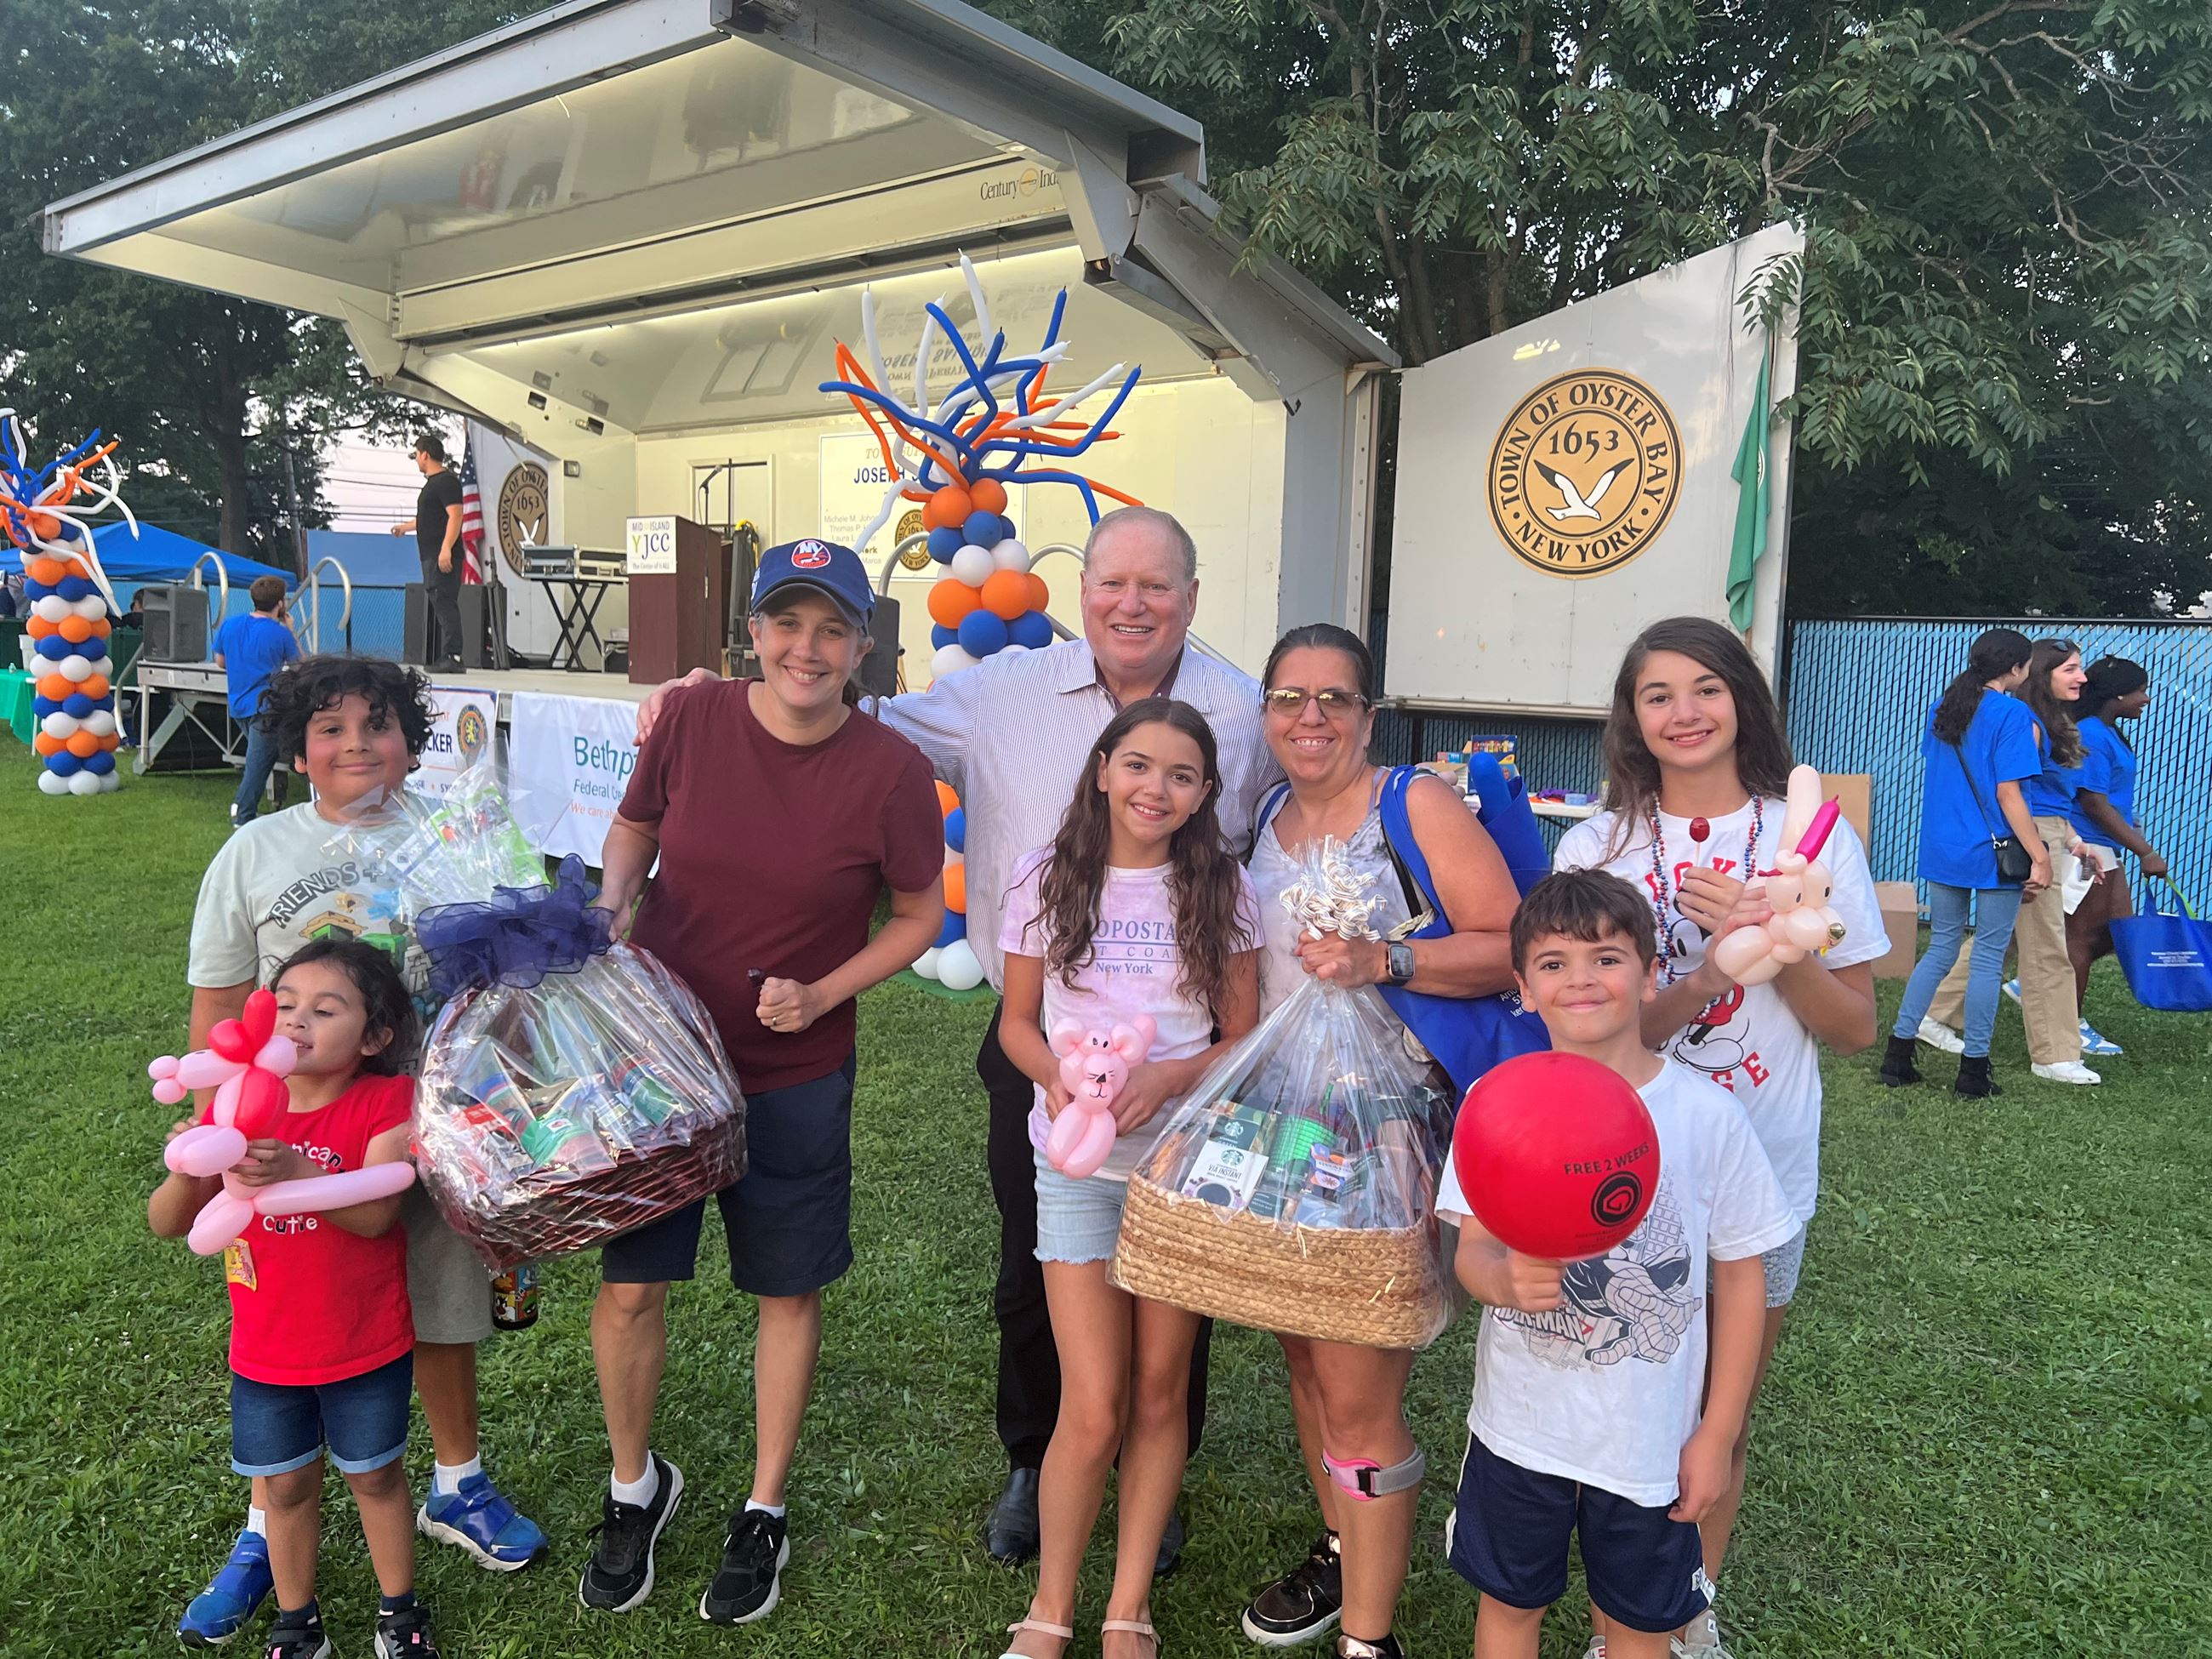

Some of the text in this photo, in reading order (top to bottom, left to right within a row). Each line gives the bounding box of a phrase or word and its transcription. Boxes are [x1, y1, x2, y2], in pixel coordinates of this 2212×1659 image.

[980, 180, 1019, 200] Century
[1499, 383, 1668, 510] TOWN OF OYSTER BAY
[1549, 419, 1619, 465] 1653
[517, 491, 539, 516] 1653
[632, 520, 670, 531] MID ISLAND
[1515, 517, 1645, 563] NEW YORK
[573, 736, 636, 781] Bethp
[573, 778, 610, 800] Federal
[571, 802, 585, 814] We
[587, 807, 603, 818] care
[1096, 962, 1154, 975] New York
[1565, 1142, 1650, 1175] FREE 2 WEEKS
[263, 1214, 317, 1234] Cutie
